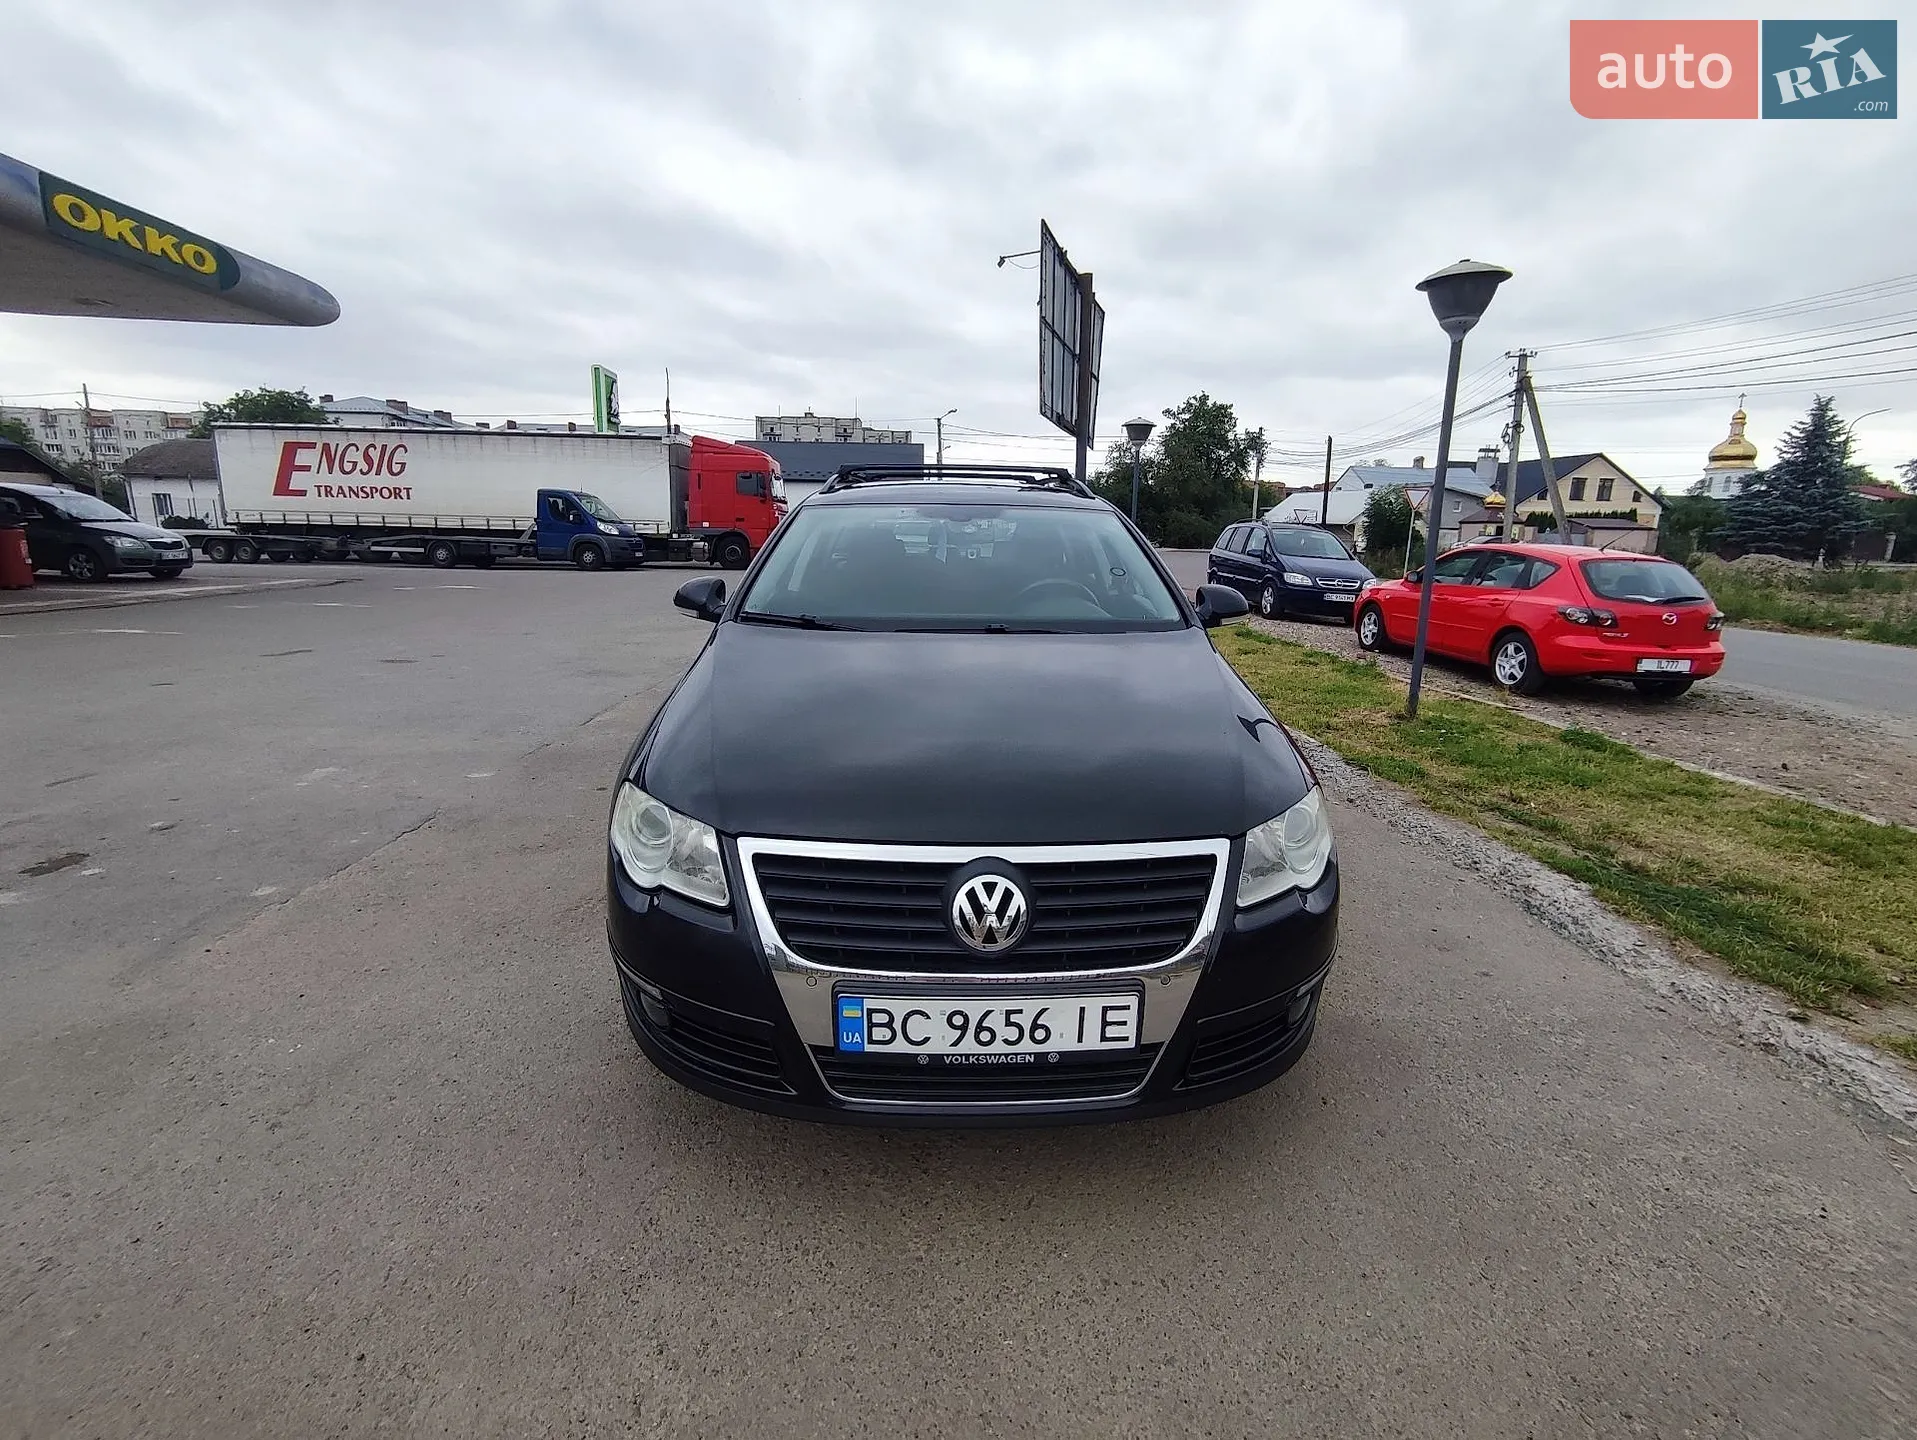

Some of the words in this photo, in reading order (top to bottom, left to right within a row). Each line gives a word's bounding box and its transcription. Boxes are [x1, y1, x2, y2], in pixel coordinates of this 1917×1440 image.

[52, 192, 218, 276] OKKO
[272, 441, 409, 497] ENGSIG
[313, 484, 413, 501] TRANSPORT
[843, 1032, 862, 1044] UA
[866, 1007, 932, 1047] BC
[946, 1007, 1052, 1048] 9656
[1077, 1004, 1131, 1044] IE
[943, 1054, 1035, 1065] VOLKSWAGEN
